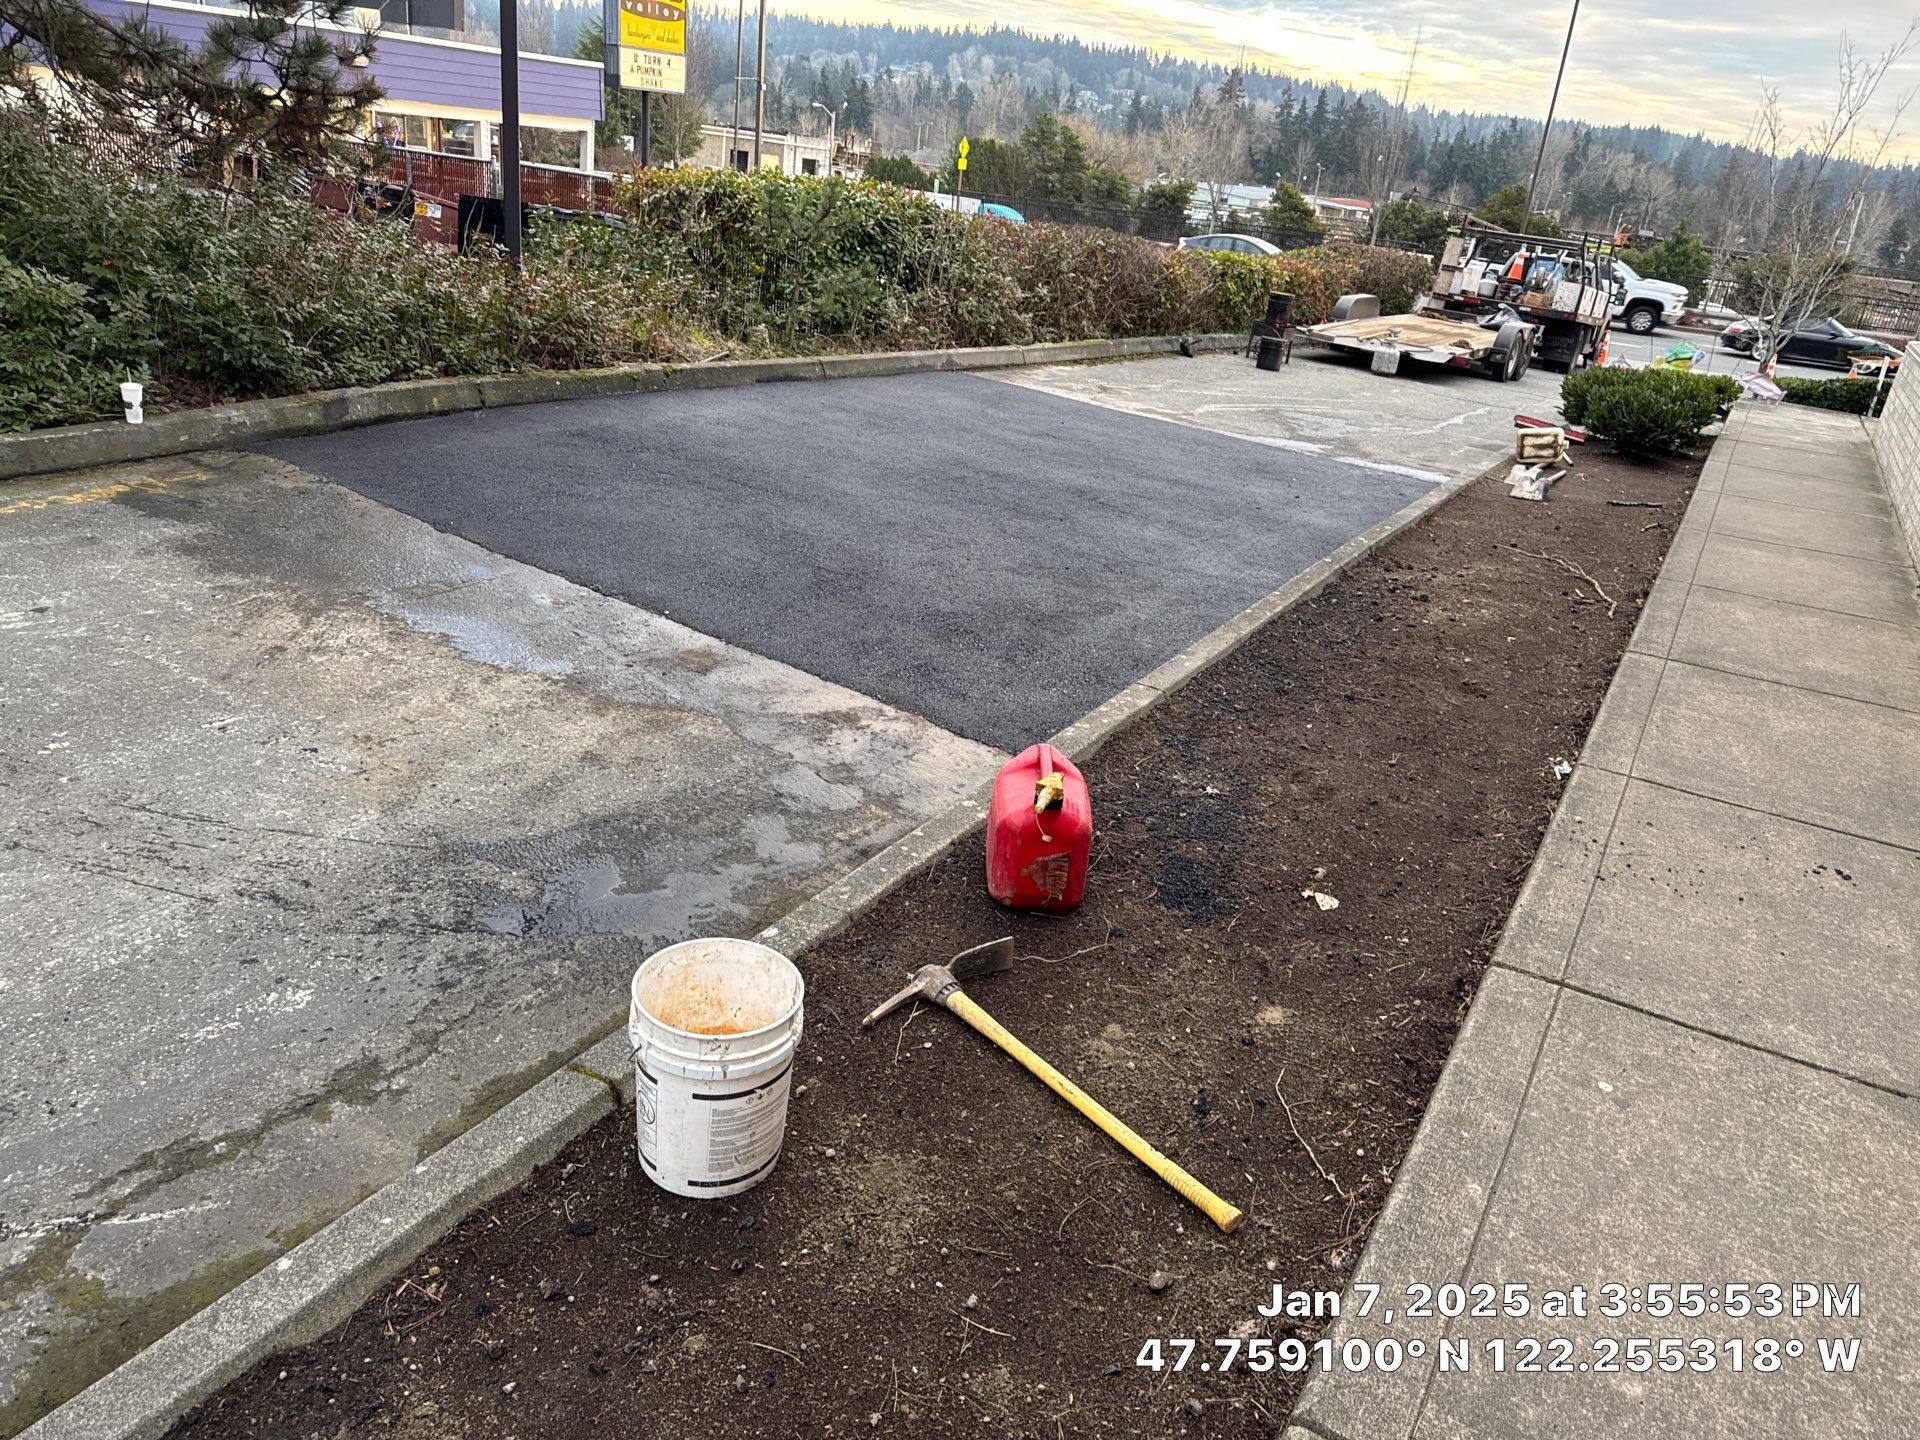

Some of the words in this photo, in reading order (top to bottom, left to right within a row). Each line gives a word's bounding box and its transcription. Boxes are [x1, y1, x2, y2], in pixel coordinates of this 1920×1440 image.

[626, 0, 680, 20] valley
[633, 53, 639, 62] U
[644, 54, 662, 66] TURN
[667, 58, 671, 68] 4
[630, 64, 634, 74] A
[637, 65, 663, 77] PUMPKIN
[641, 77, 663, 89] SHAKE
